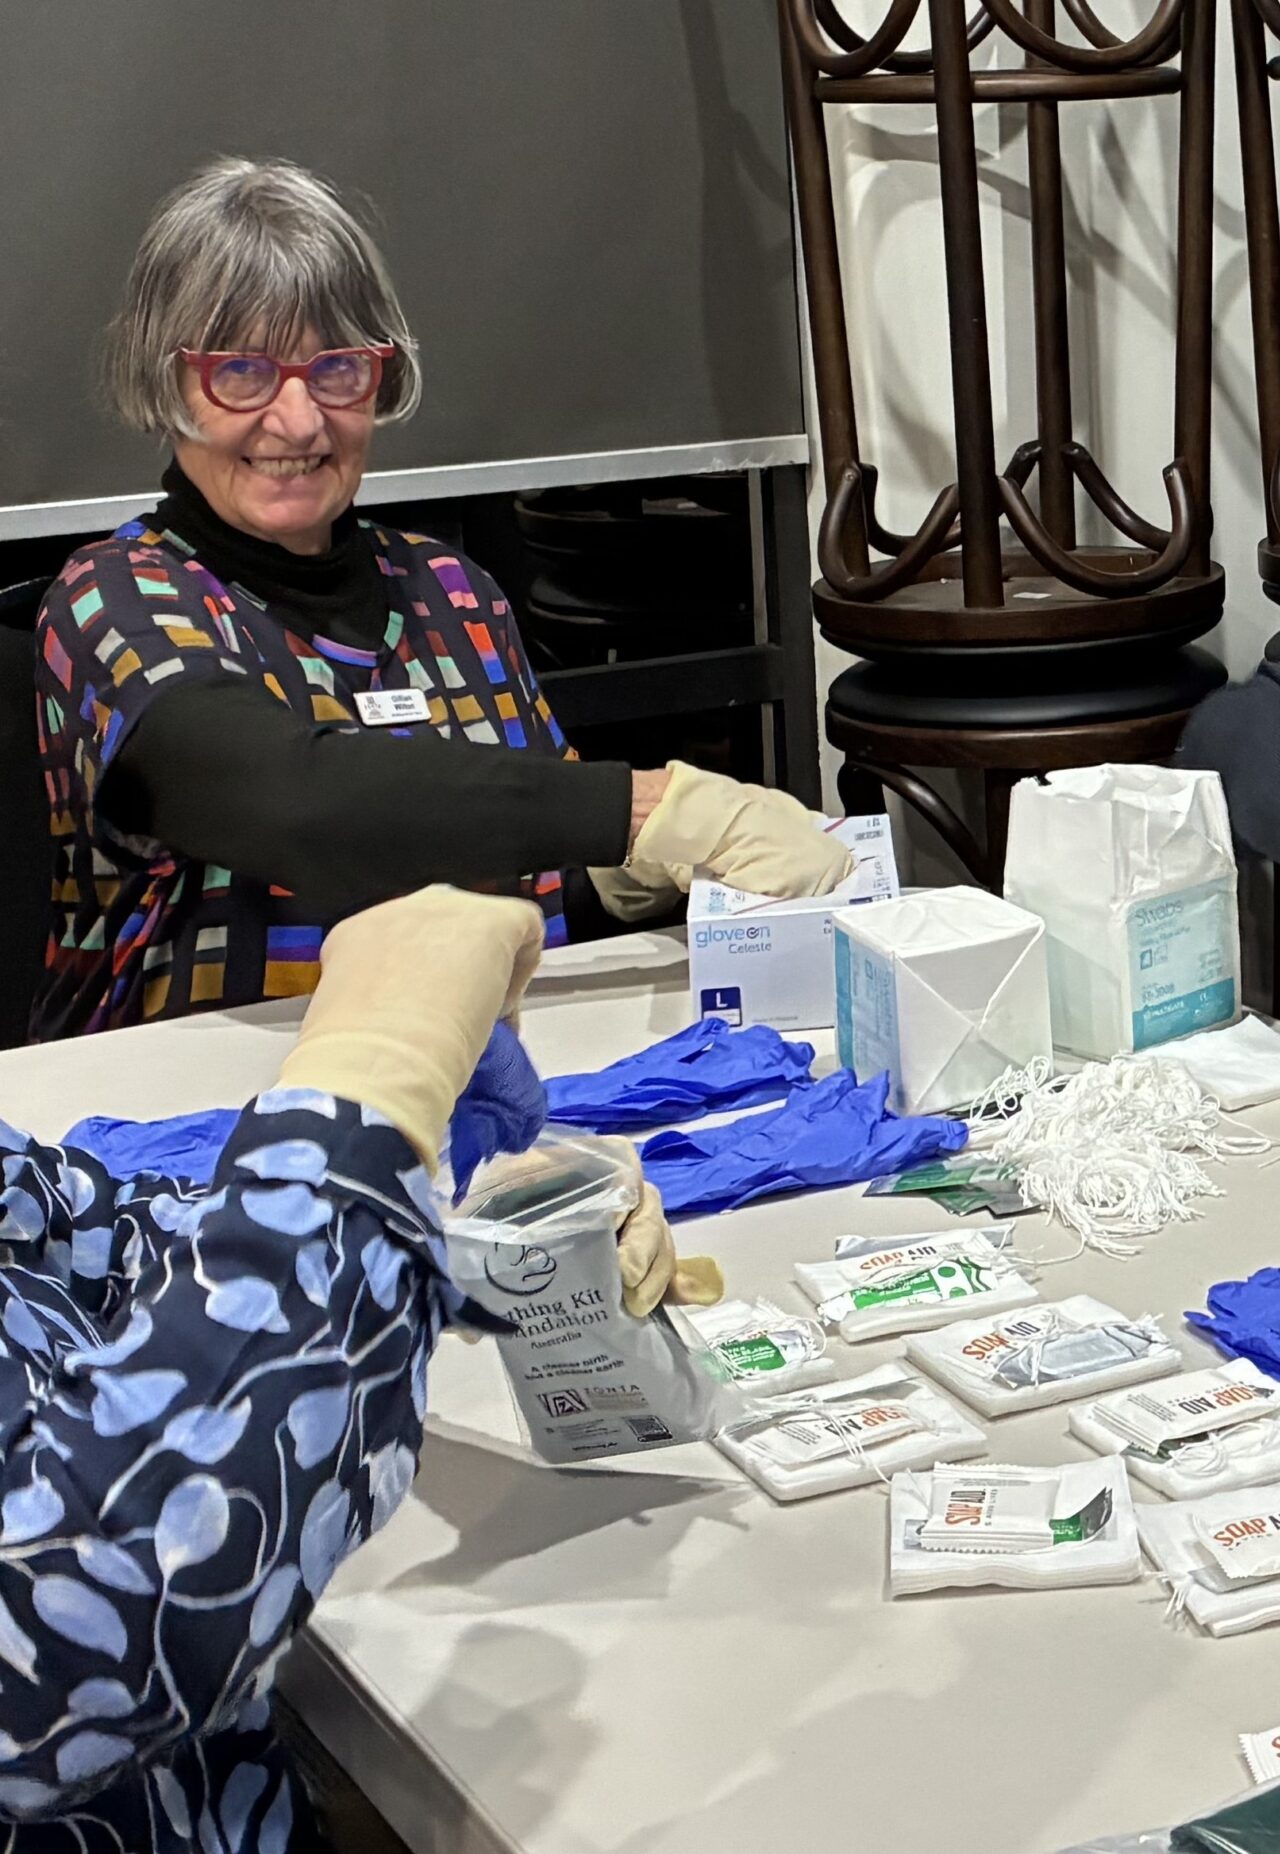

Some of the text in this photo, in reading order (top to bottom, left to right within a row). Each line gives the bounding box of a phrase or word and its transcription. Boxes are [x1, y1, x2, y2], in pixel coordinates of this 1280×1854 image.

[728, 942, 773, 954] Celeste
[715, 992, 729, 1008] L
[506, 1288, 605, 1322] thing Kit
[1004, 1321, 1041, 1337] AID
[1178, 1396, 1217, 1415] AID
[1213, 1386, 1259, 1407] OAP
[1213, 1518, 1267, 1547] SOAP
